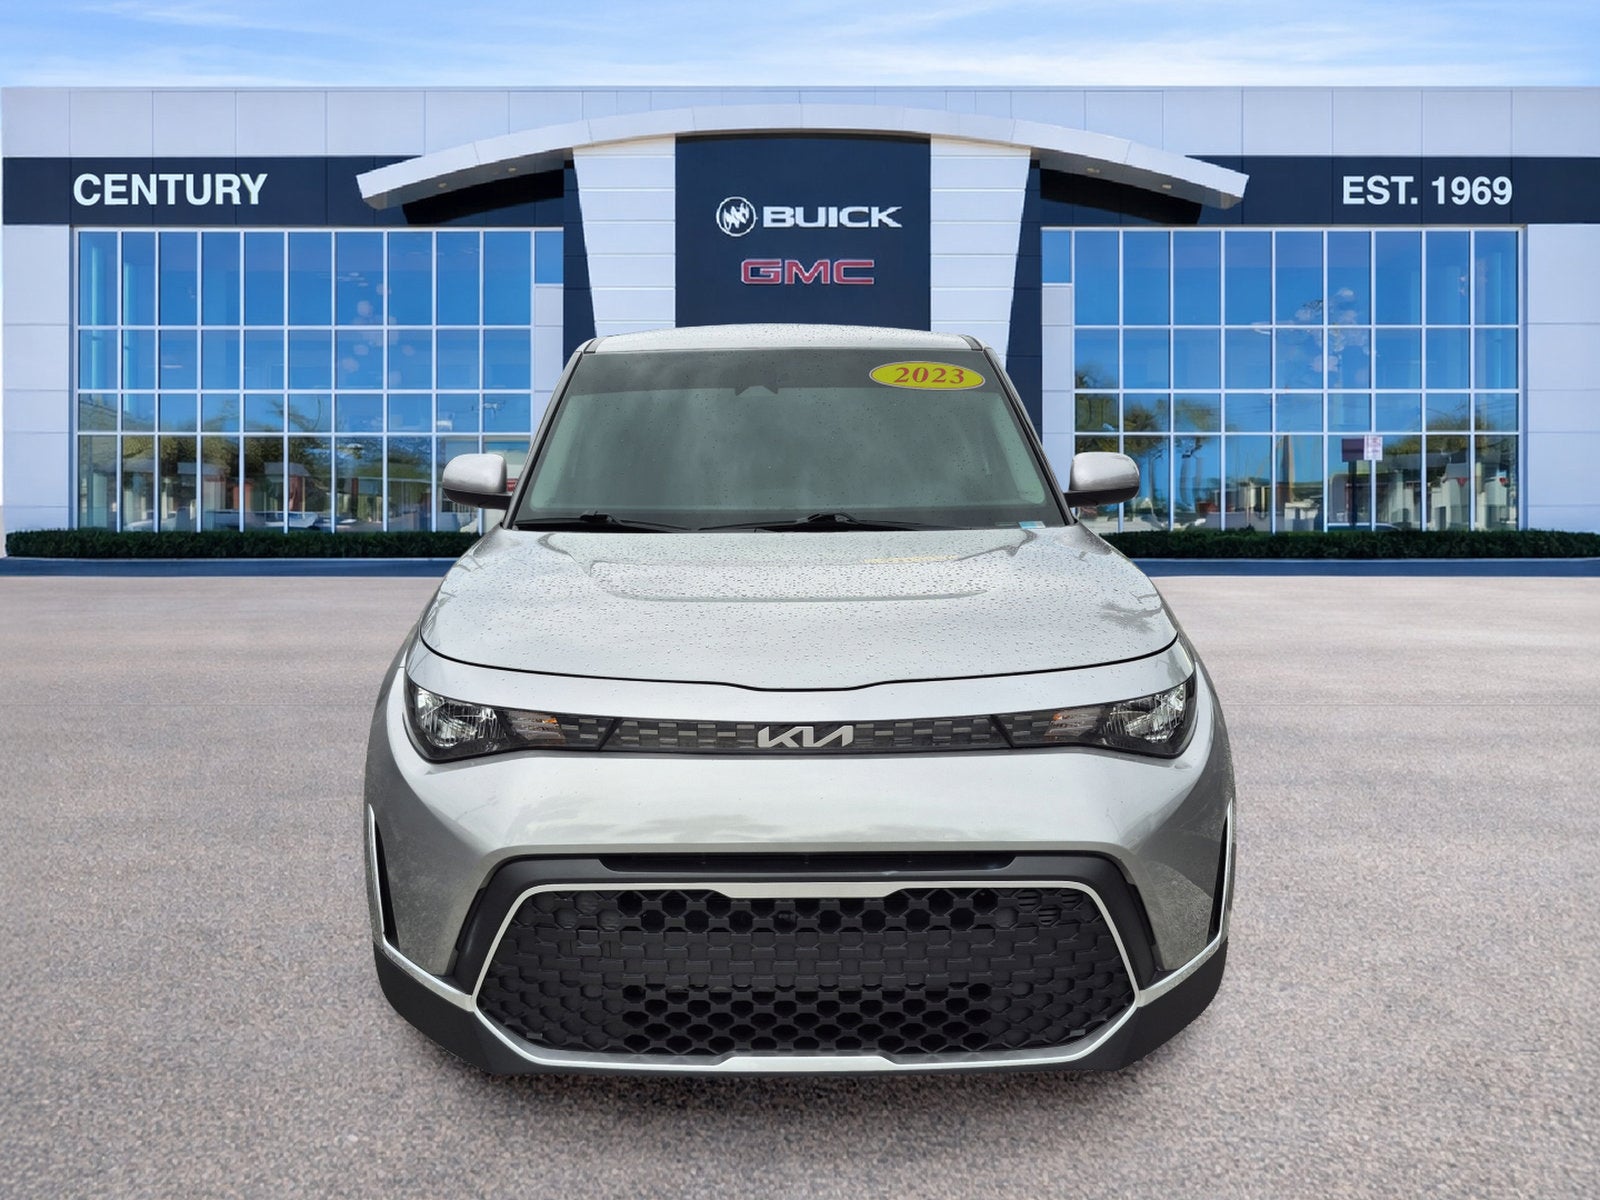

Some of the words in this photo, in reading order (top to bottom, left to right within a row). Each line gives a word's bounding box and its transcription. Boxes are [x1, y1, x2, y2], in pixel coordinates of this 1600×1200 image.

[73, 173, 268, 206] CENTURY
[1343, 175, 1418, 205] EST.
[1431, 176, 1513, 205] 1969
[762, 206, 903, 228] BUICK
[741, 259, 875, 285] GMC
[894, 367, 965, 384] 2023
[758, 725, 854, 747] KIA
